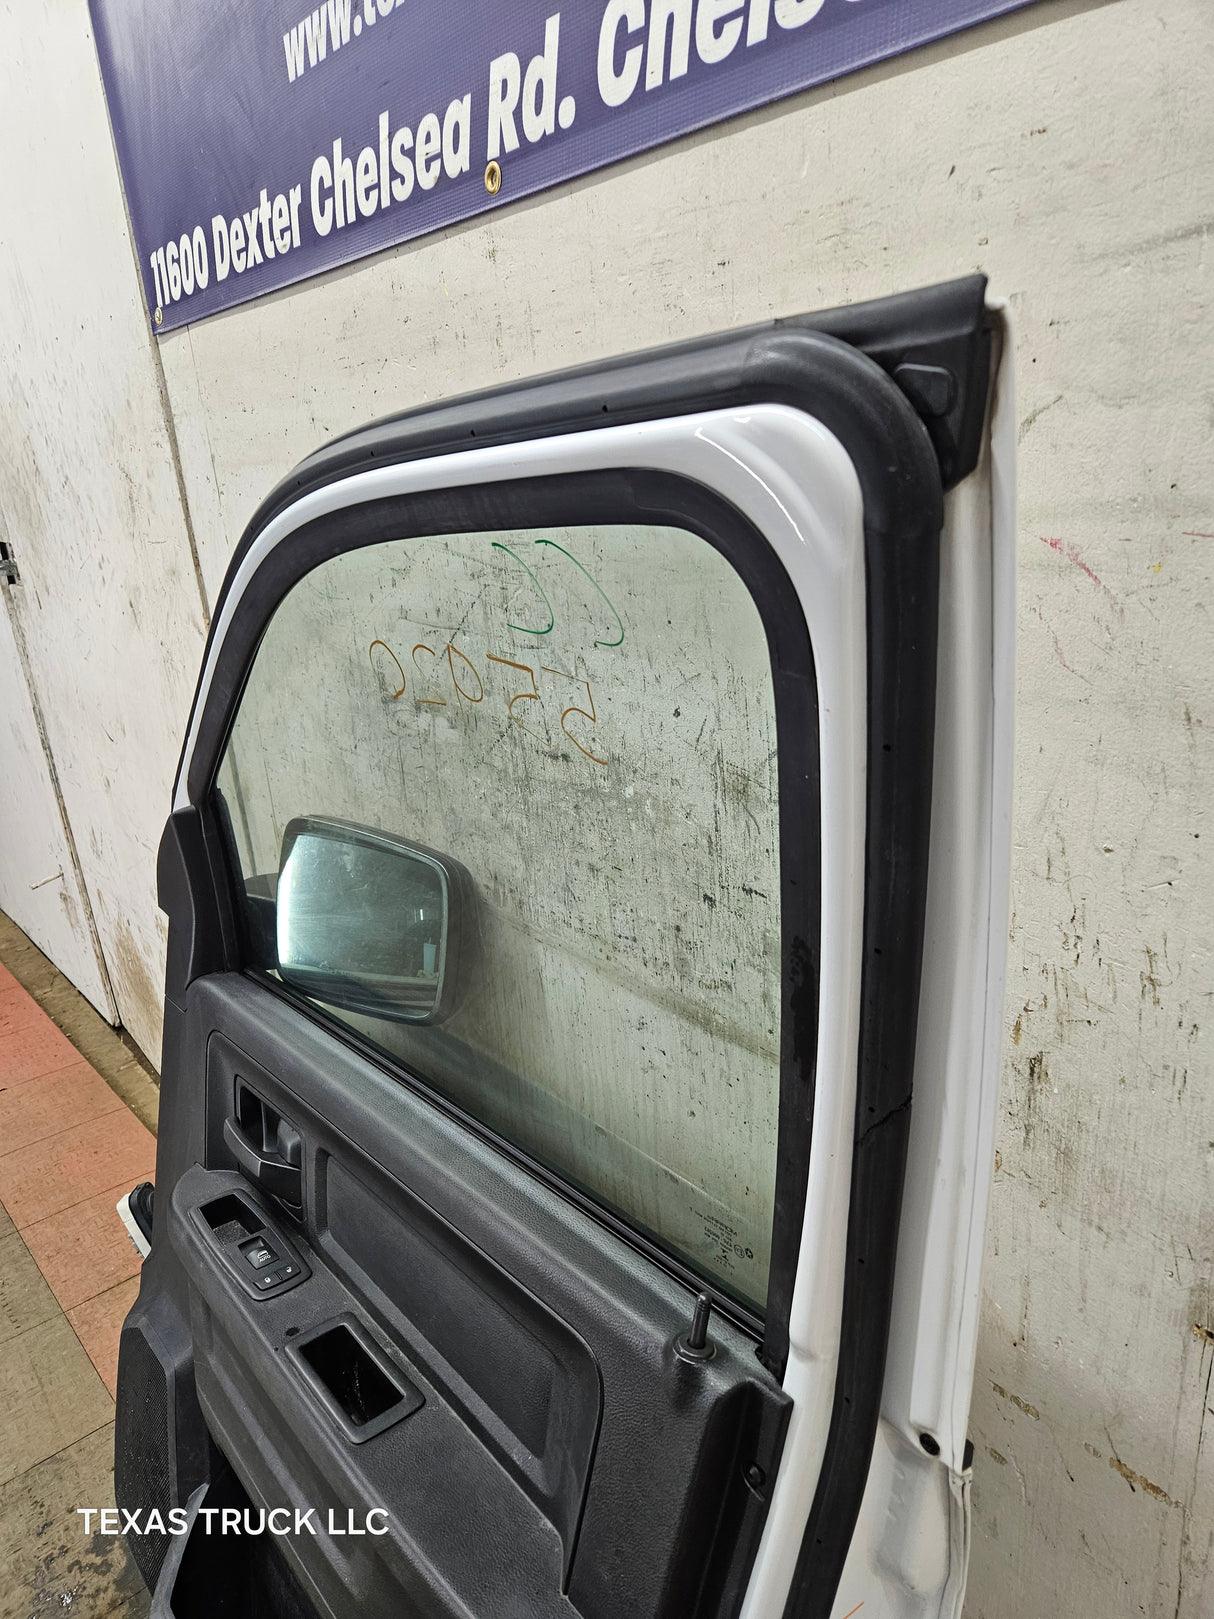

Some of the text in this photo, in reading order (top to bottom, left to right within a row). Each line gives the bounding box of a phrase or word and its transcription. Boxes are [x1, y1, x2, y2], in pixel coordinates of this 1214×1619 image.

[150, 226, 209, 307] 11600
[211, 184, 301, 282] Dexter
[310, 93, 472, 236] Chelsea
[487, 12, 576, 161] Rd.
